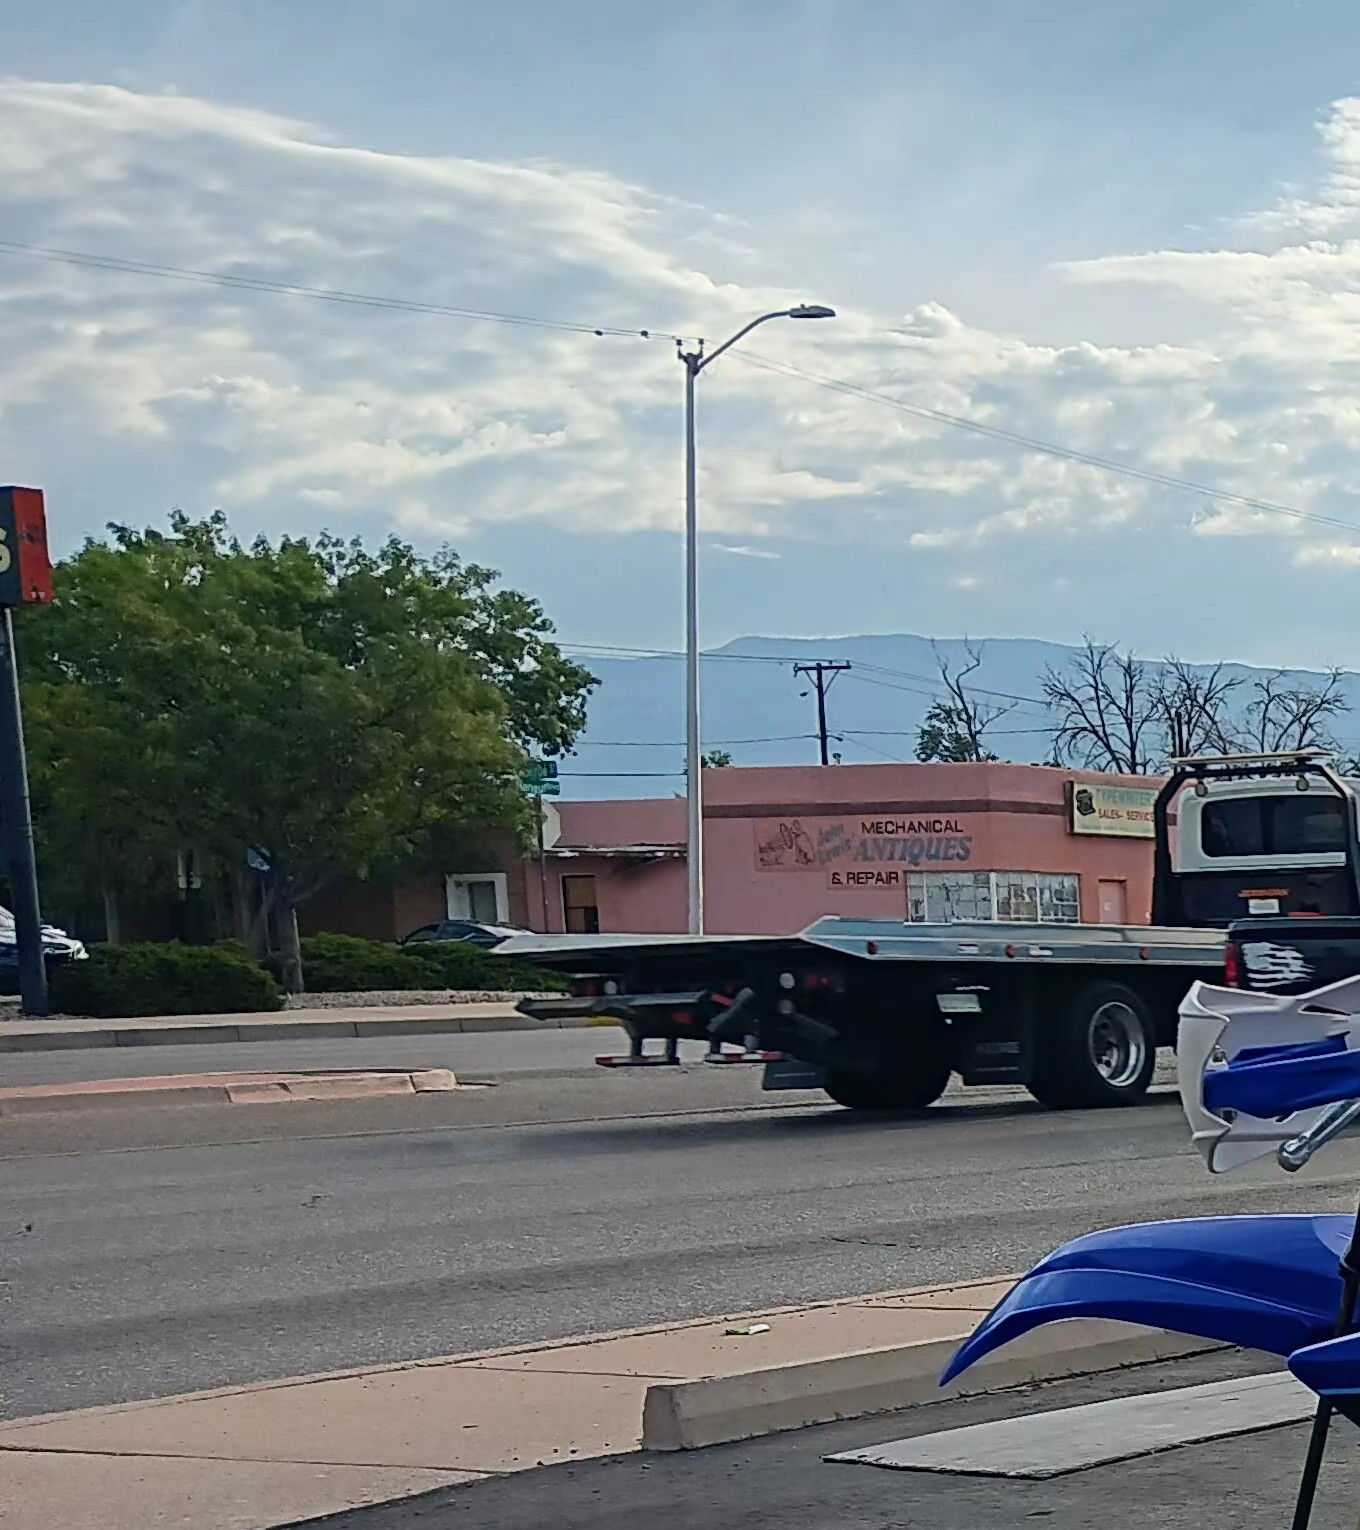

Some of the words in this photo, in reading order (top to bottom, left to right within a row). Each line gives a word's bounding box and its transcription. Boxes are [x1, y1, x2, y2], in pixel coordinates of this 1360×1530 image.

[861, 819, 964, 834] MECHANICAL
[854, 836, 973, 867] ANTIQUES
[831, 871, 843, 885] &
[846, 871, 899, 885] REPAIR
